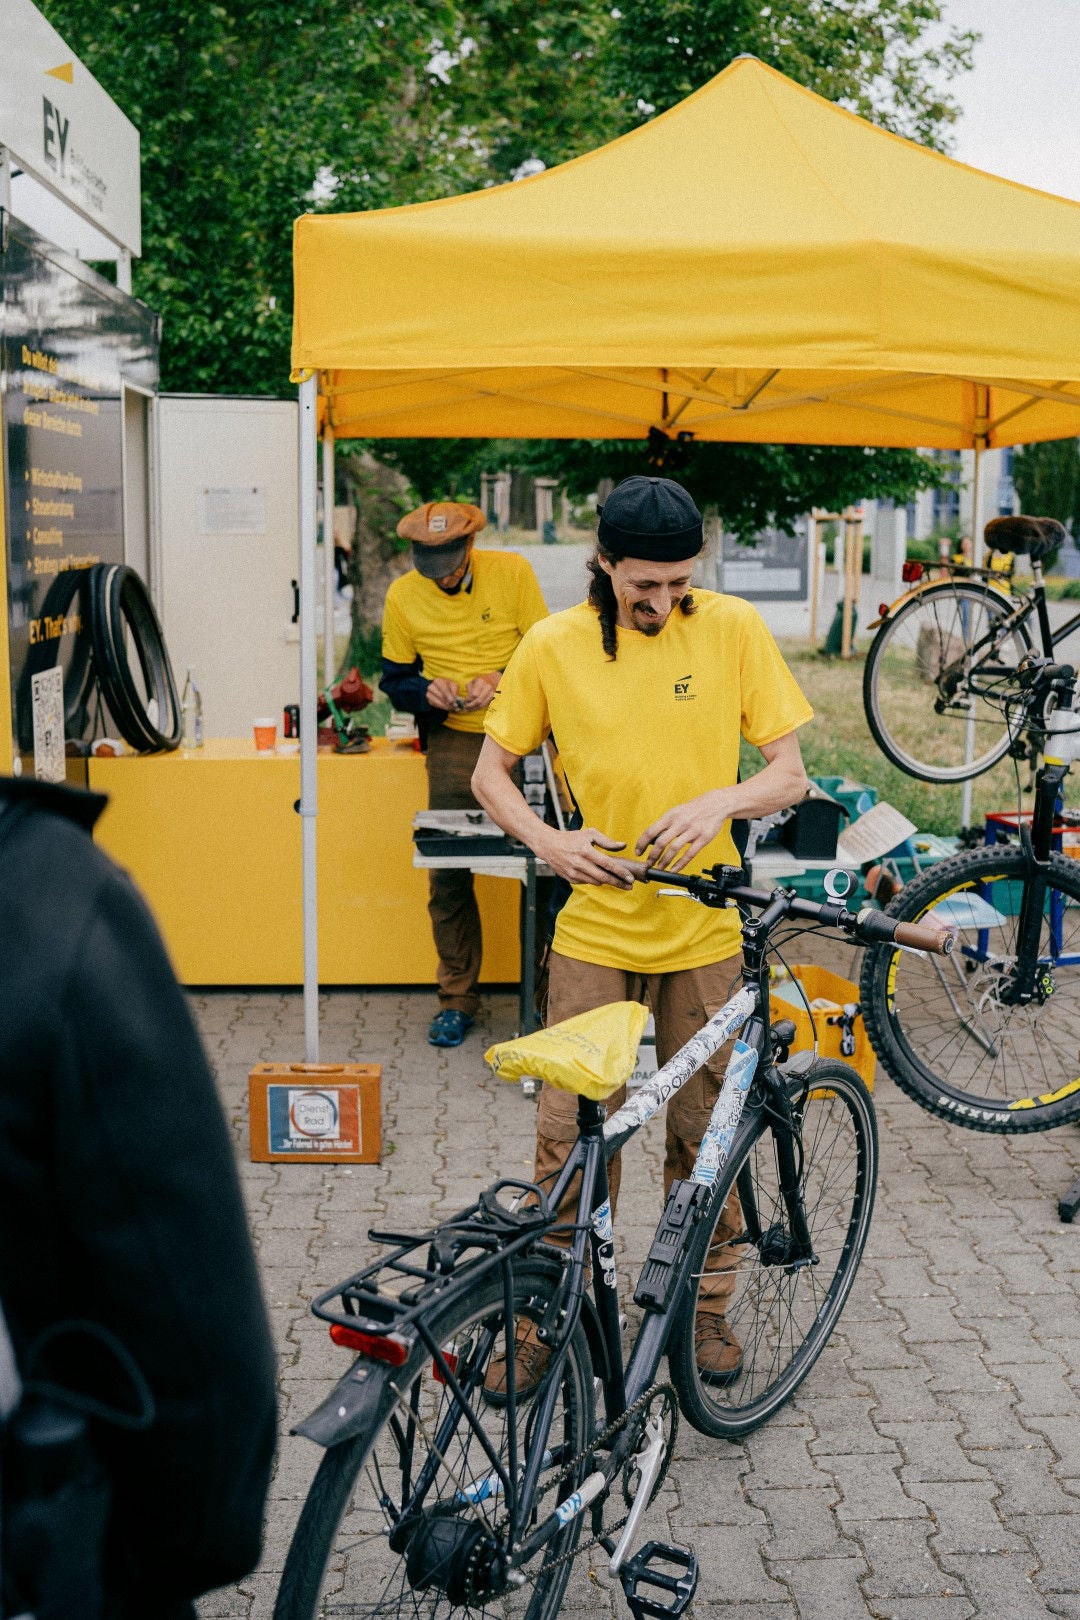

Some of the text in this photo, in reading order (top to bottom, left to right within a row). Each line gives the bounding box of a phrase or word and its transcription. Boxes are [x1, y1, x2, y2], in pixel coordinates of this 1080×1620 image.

[42, 95, 70, 179] EY
[674, 683, 690, 694] EY
[937, 1096, 1011, 1123] MAXXIS
[304, 1116, 324, 1125] Rad
